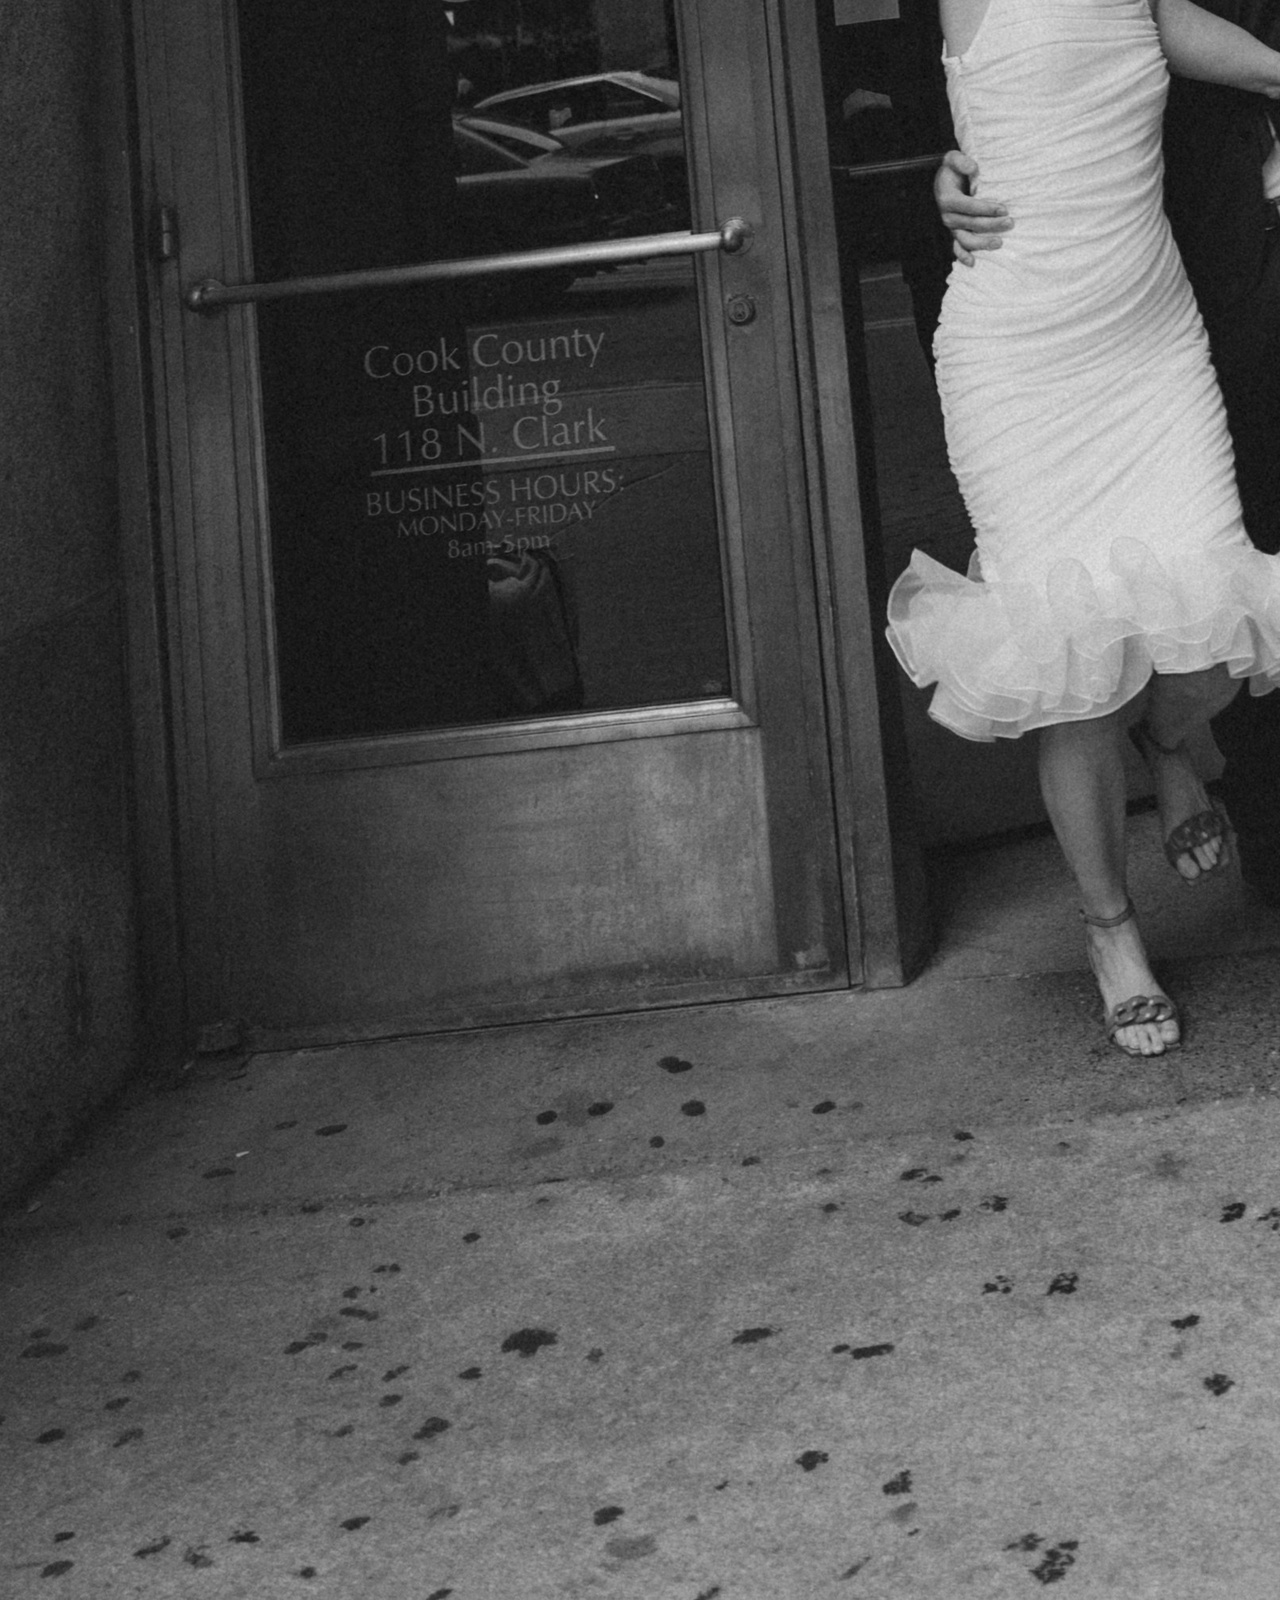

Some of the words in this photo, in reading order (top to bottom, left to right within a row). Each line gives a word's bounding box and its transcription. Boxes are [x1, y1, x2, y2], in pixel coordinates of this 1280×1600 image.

[364, 337, 460, 378] Cook
[472, 329, 604, 367] County
[413, 374, 562, 417] Building
[373, 428, 442, 464] 118
[456, 421, 498, 456] N.
[512, 408, 607, 450] Clark
[366, 479, 501, 516] BUSINESS
[510, 468, 624, 502] HOURS:
[397, 500, 596, 538] MONDAY-FRIDAY
